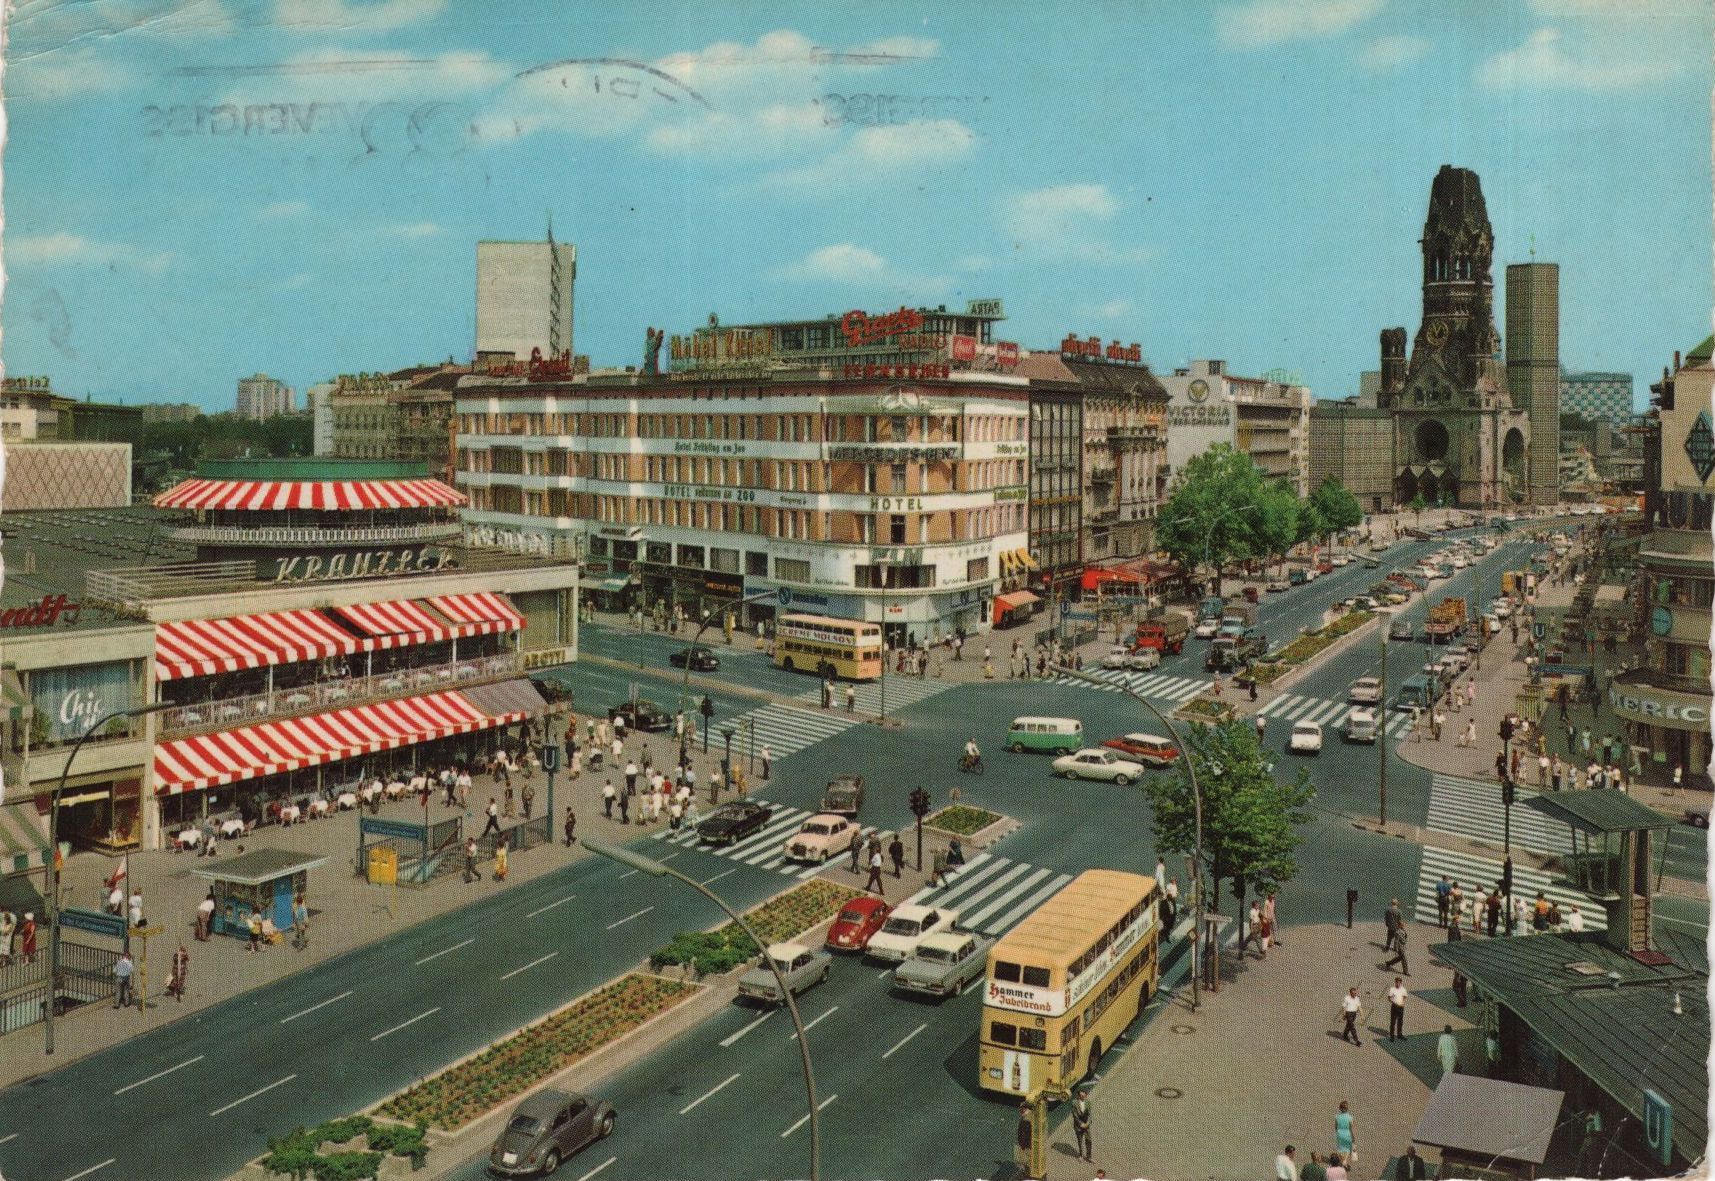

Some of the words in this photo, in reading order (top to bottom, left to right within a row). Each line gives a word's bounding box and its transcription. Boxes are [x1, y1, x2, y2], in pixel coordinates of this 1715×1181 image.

[1168, 405, 1230, 418] VICTORIA
[737, 490, 755, 502] ZOO
[870, 497, 923, 510] HOTEL
[276, 549, 459, 583] KRANZLER
[989, 982, 1035, 1000] Hammer
[1646, 1102, 1660, 1149] U
